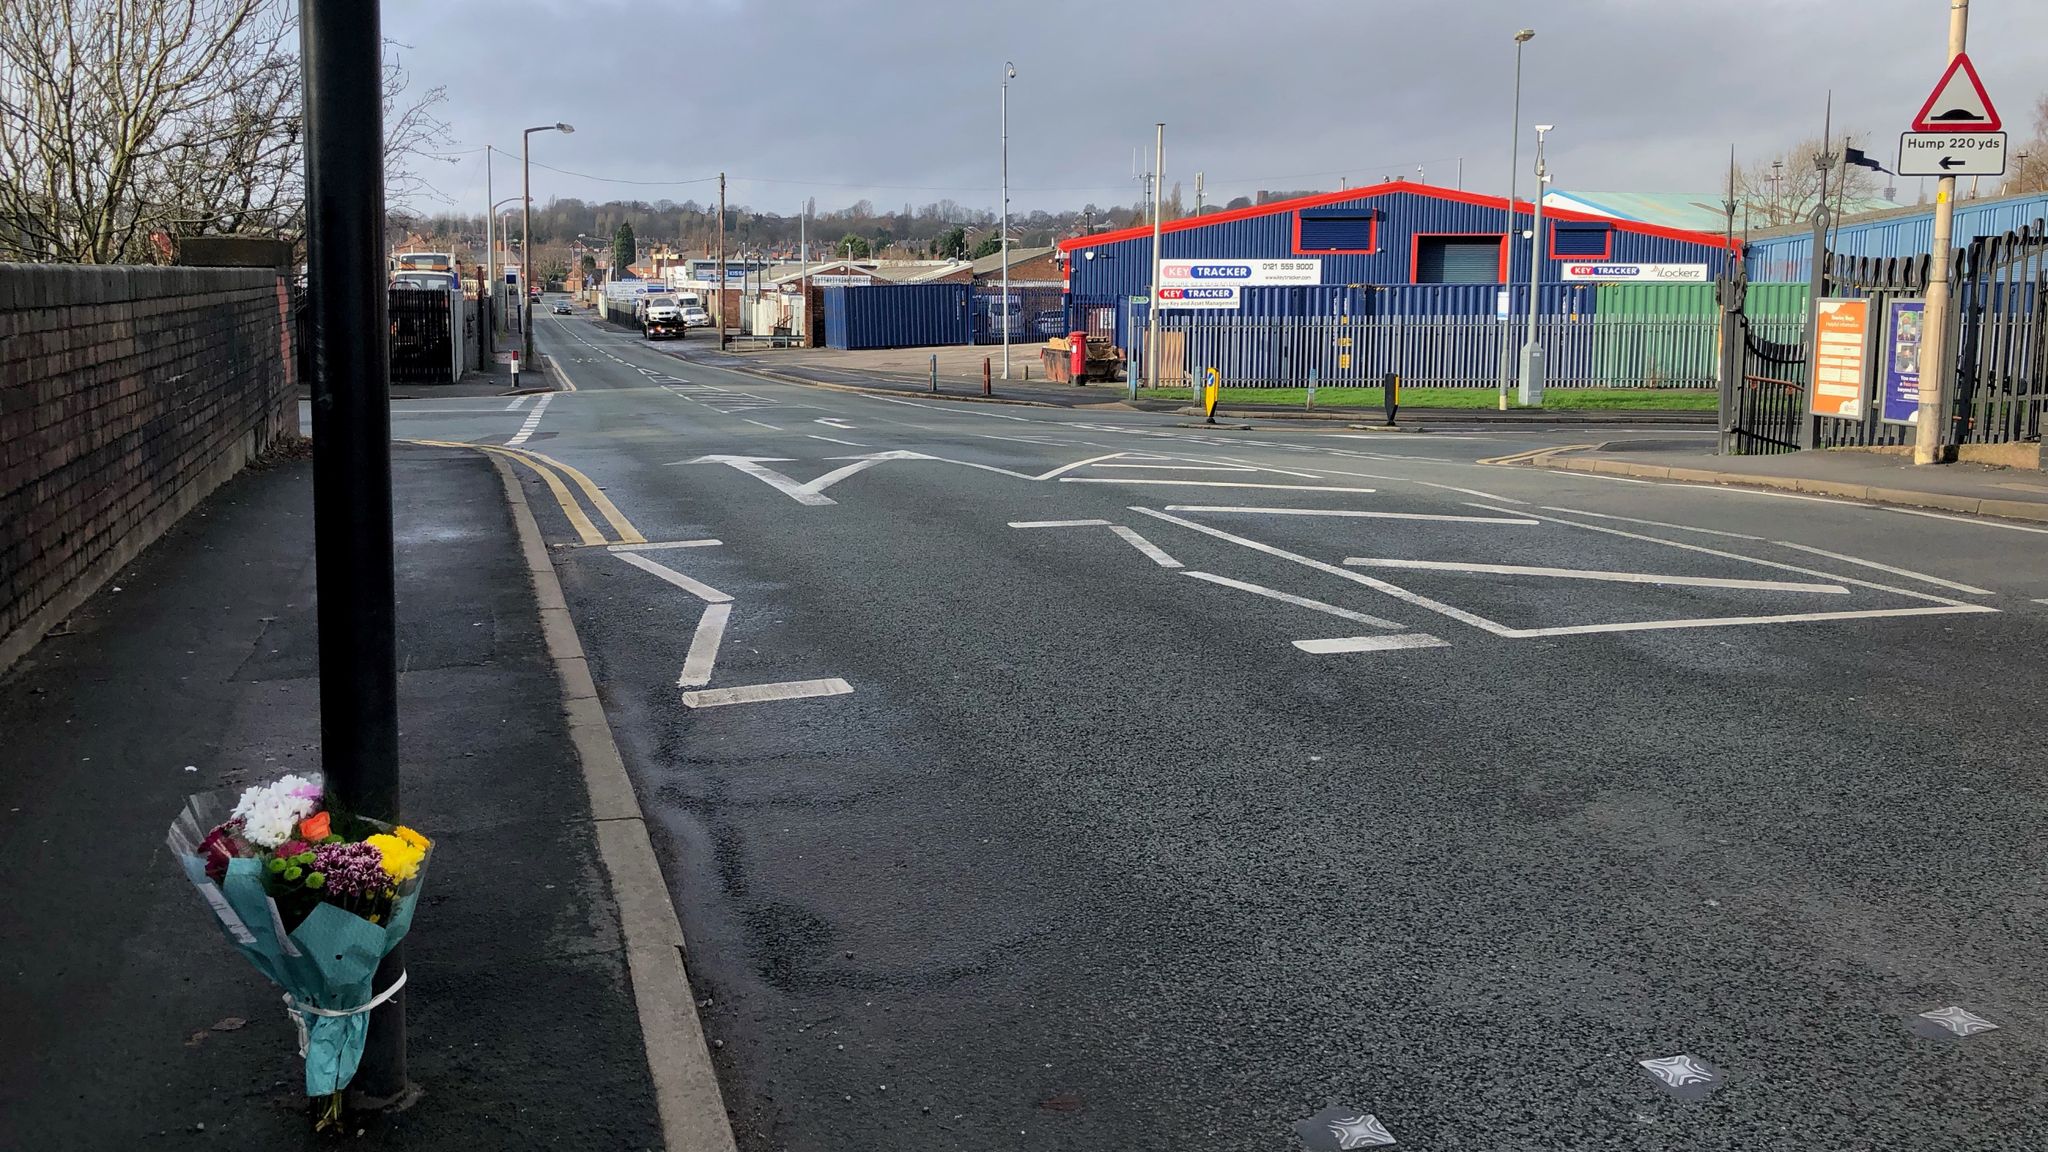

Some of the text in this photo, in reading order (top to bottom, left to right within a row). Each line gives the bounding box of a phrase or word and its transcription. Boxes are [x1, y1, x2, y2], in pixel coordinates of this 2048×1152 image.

[1907, 138, 2000, 150] Hump 220 yds
[1262, 263, 1278, 271] 0121
[1296, 263, 1314, 271] 9000
[1575, 267, 1637, 275] KEY TRACKER
[1168, 267, 1247, 277] KEY TRACKER
[1163, 289, 1230, 298] KEY TRACKER
